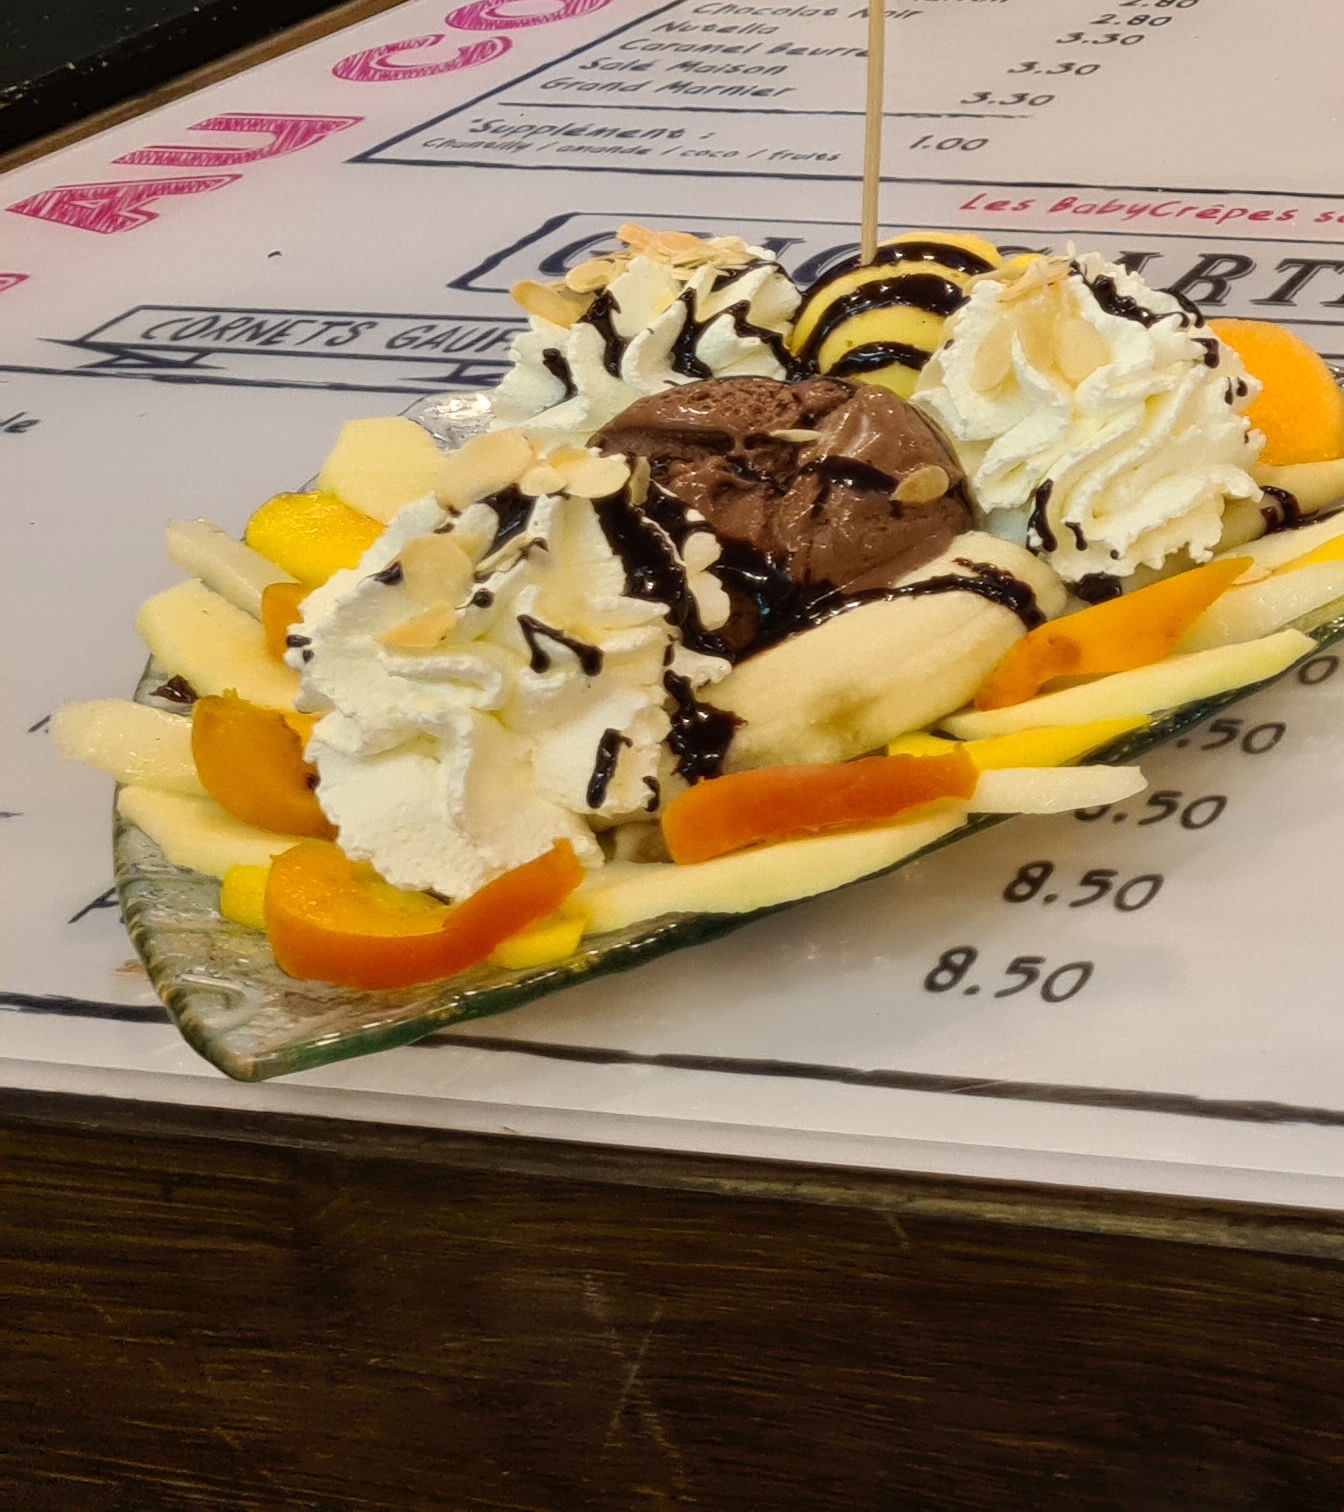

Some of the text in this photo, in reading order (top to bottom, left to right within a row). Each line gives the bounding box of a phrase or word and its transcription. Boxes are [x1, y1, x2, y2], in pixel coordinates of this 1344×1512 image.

[692, 2, 839, 17] Chocolat
[651, 20, 780, 35] Nutella
[1090, 13, 1173, 27] 2.80
[618, 38, 763, 55] Caramel
[1055, 31, 1145, 46] 3.30
[578, 56, 788, 76] Salé Maison
[1007, 61, 1101, 76] 3.30
[539, 76, 796, 97] Grand Marnier
[960, 91, 1056, 107] 3.30
[909, 134, 990, 152] 1.00
[555, 145, 653, 156] amande
[679, 149, 740, 158] coco
[767, 149, 842, 162] fruits
[960, 193, 1035, 212] Les
[140, 314, 379, 347] CORNETS
[1001, 860, 1164, 912] 8.50
[923, 944, 1094, 1004] 8.50
